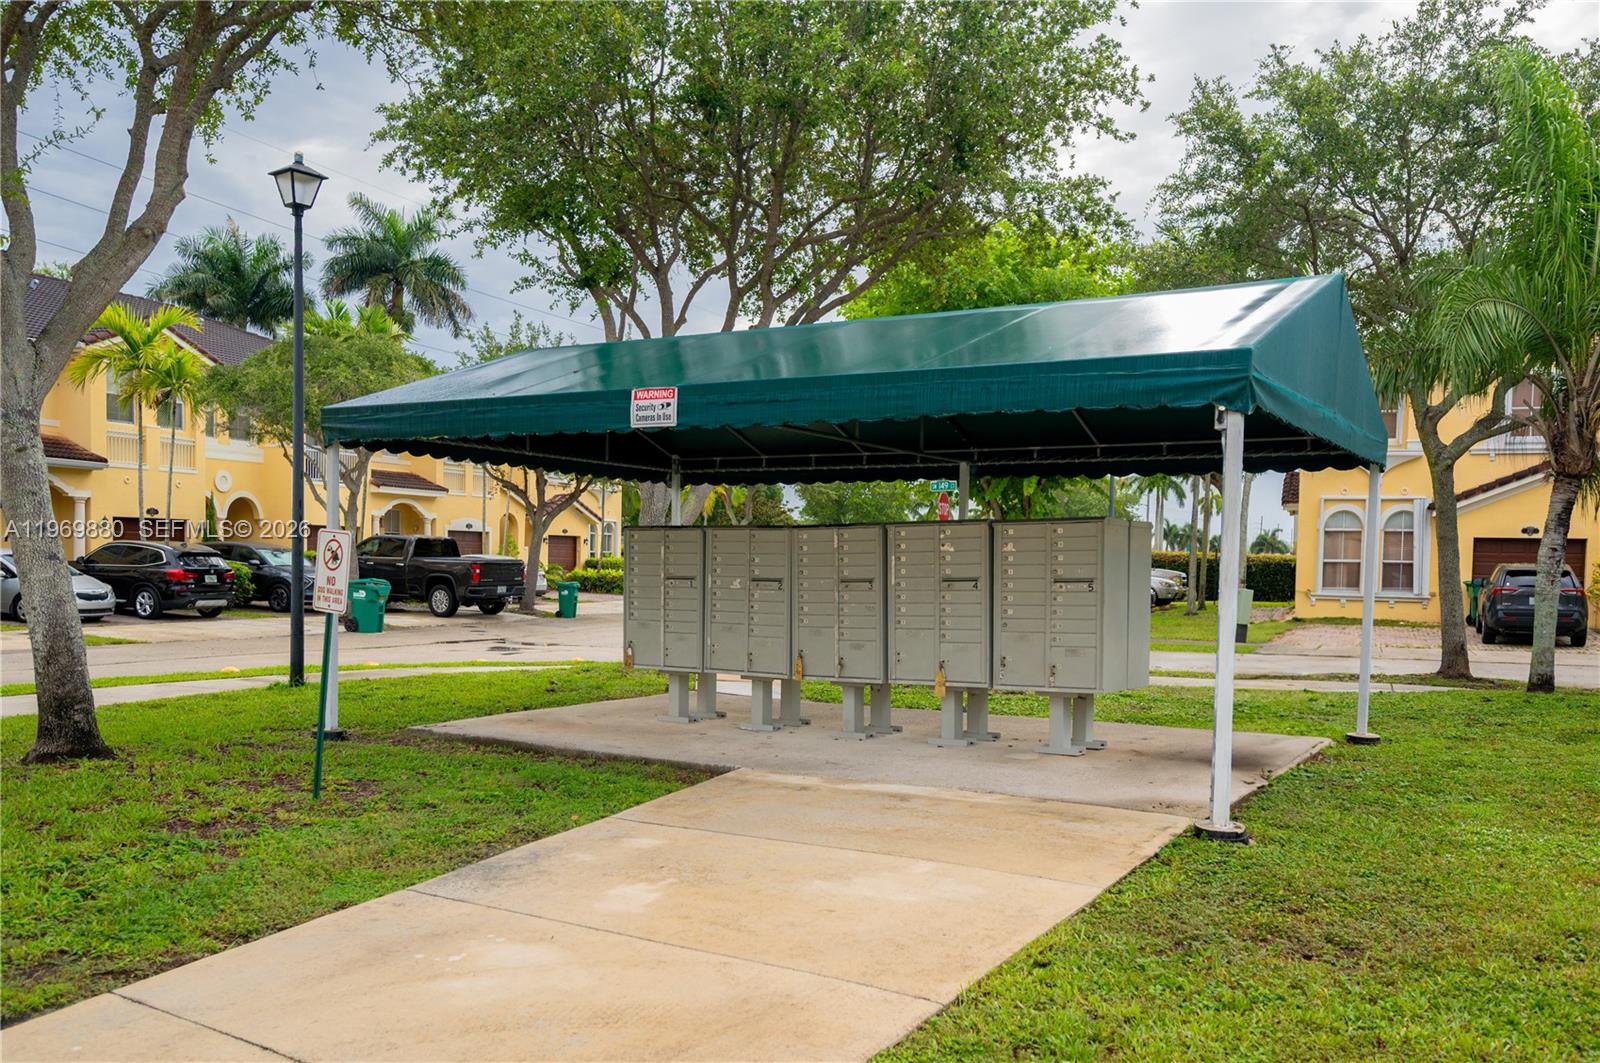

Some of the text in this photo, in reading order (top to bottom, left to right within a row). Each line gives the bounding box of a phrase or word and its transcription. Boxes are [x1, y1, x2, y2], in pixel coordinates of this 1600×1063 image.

[636, 389, 674, 399] WARNING
[636, 402, 656, 412] Security
[636, 412, 671, 422] Cameras In Use
[326, 576, 336, 586] NO
[778, 582, 783, 591] 2
[868, 582, 873, 590] 3
[973, 582, 978, 590] 4
[1088, 583, 1094, 592] 5
[327, 587, 343, 596] WALKING
[332, 597, 342, 605] AREA
